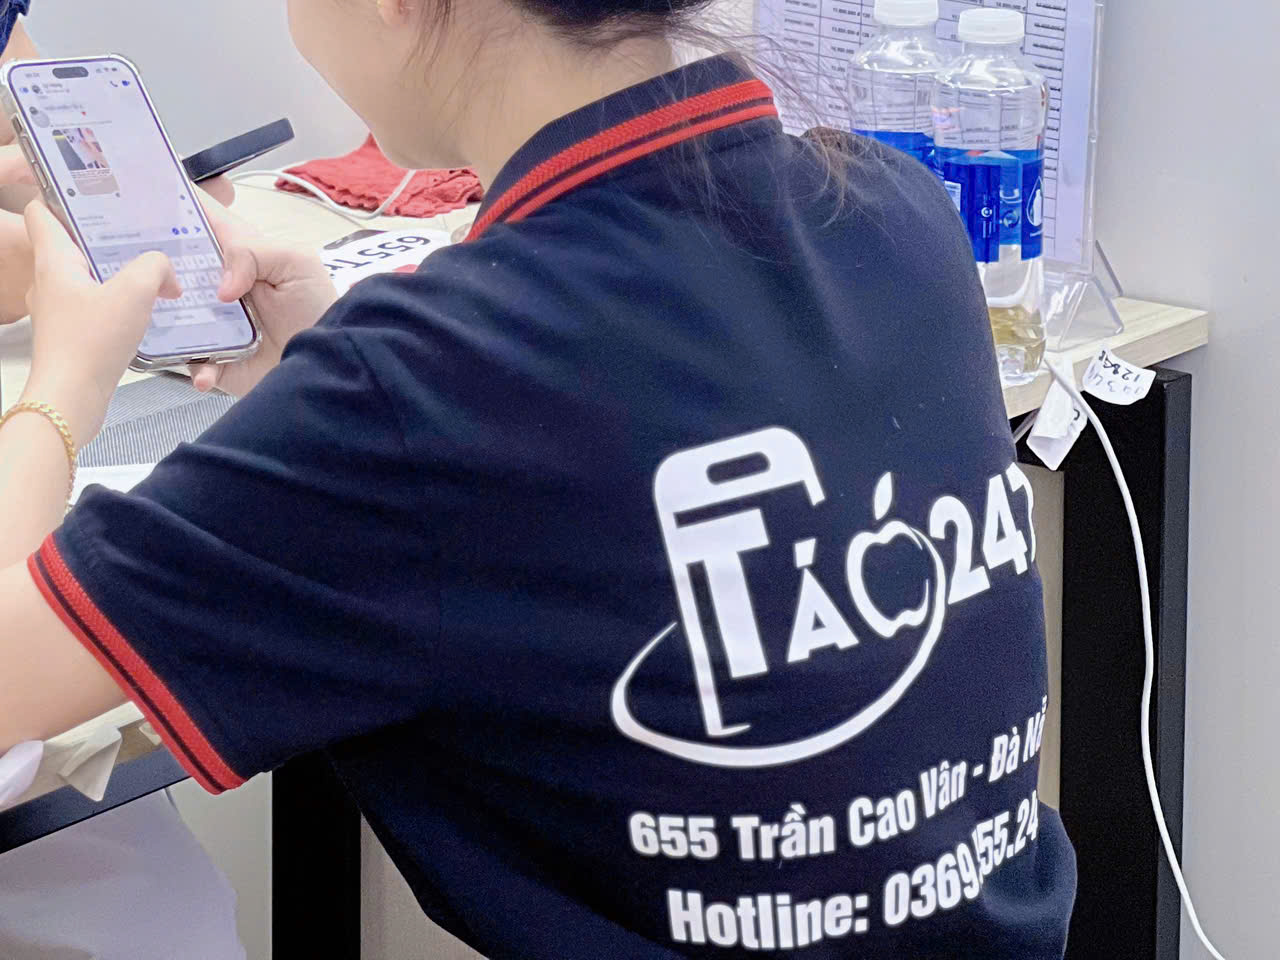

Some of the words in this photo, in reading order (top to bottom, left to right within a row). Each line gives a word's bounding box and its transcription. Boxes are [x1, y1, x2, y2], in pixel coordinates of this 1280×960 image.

[629, 812, 718, 859] 655
[732, 803, 836, 861] Trần
[848, 790, 916, 848] Cao
[921, 760, 967, 819] Vân
[988, 725, 1020, 783] Đà
[667, 889, 869, 950] Hotline:
